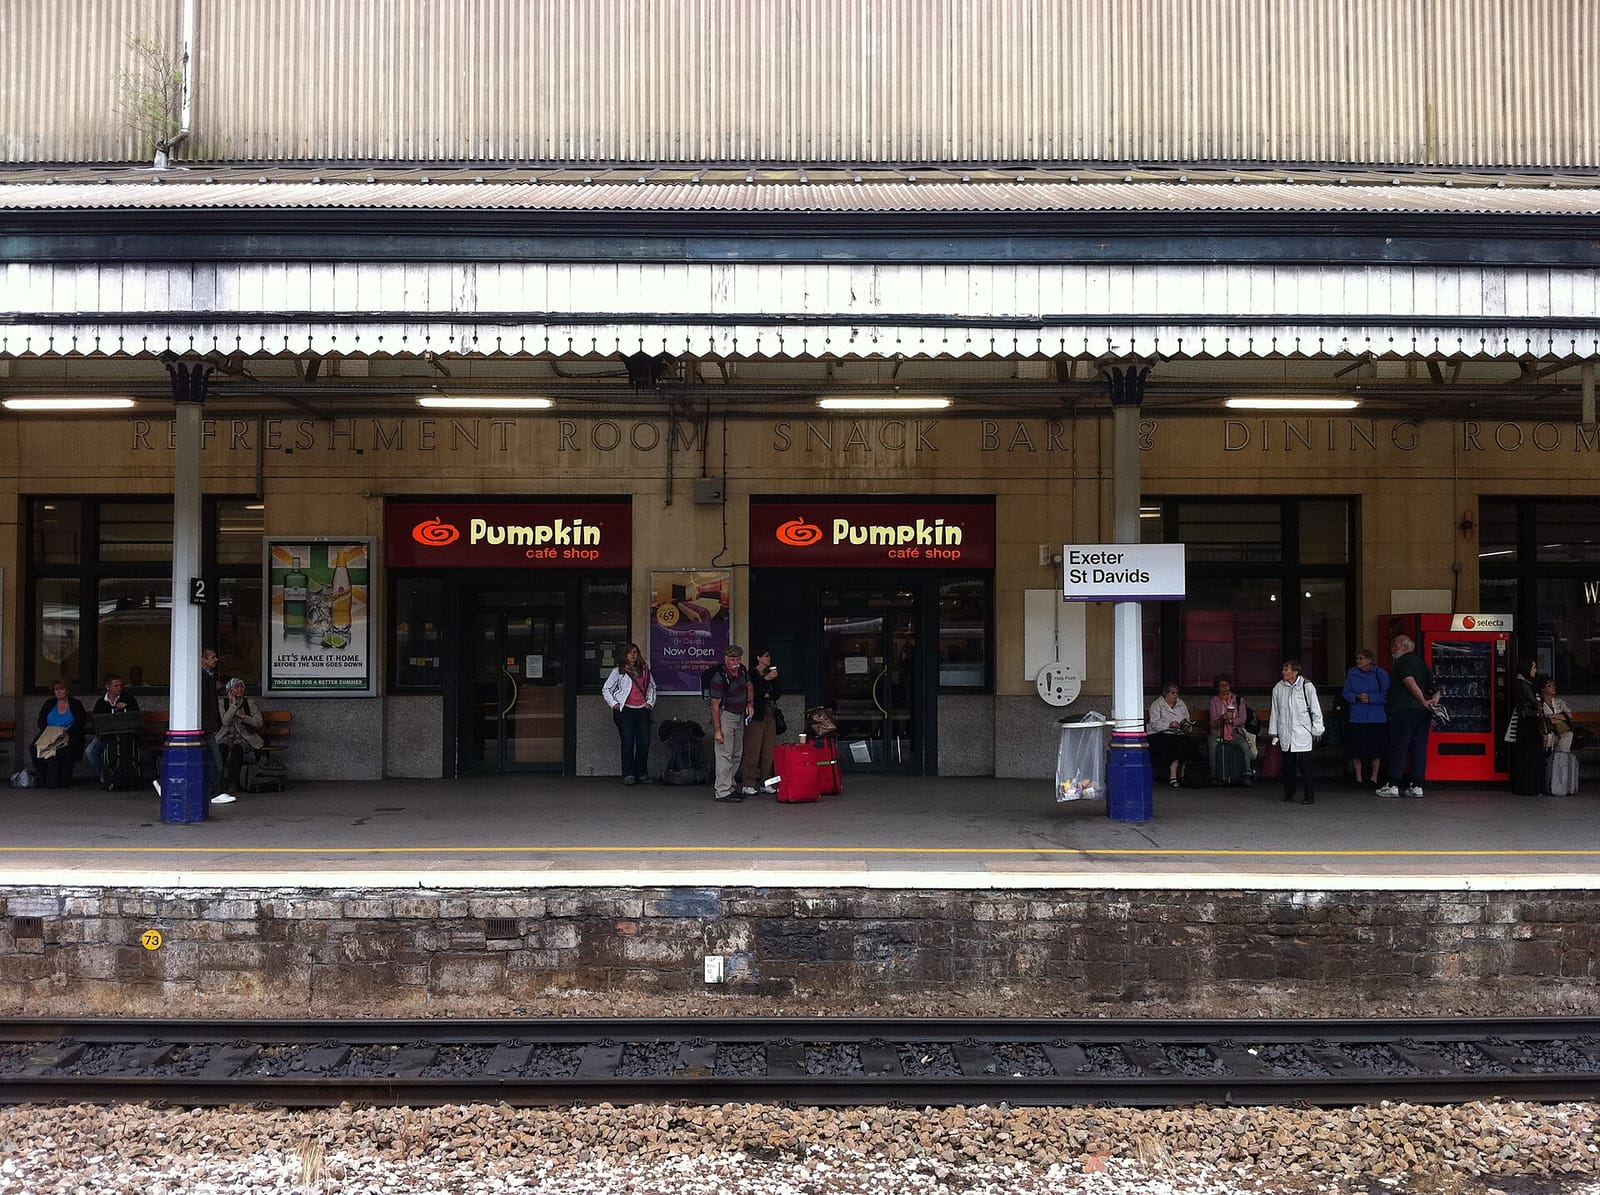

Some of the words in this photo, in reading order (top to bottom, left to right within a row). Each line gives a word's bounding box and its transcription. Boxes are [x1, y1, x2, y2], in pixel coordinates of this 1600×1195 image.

[558, 419, 703, 452] ROOM
[773, 420, 940, 452] SNACK
[980, 420, 1069, 452] BAR
[1138, 419, 1159, 451] &
[1223, 419, 1420, 451] DINING
[470, 518, 601, 546] Pumpkin
[833, 518, 963, 546] Pumpkin
[526, 547, 558, 559] café
[563, 547, 600, 560] shop
[888, 547, 920, 559] café
[925, 547, 961, 560] shop
[1069, 550, 1124, 565] Exeter
[1070, 569, 1088, 584] St
[1093, 568, 1150, 584] Davids
[195, 580, 205, 598] 2
[1584, 580, 1600, 605] W
[1477, 618, 1504, 627] selecta
[277, 652, 298, 662] LET'S
[300, 654, 324, 662] MAKE
[326, 654, 333, 662] IT
[335, 654, 360, 662] HOME
[663, 647, 686, 656] Now
[687, 646, 715, 658] Open
[144, 935, 159, 946] 73
